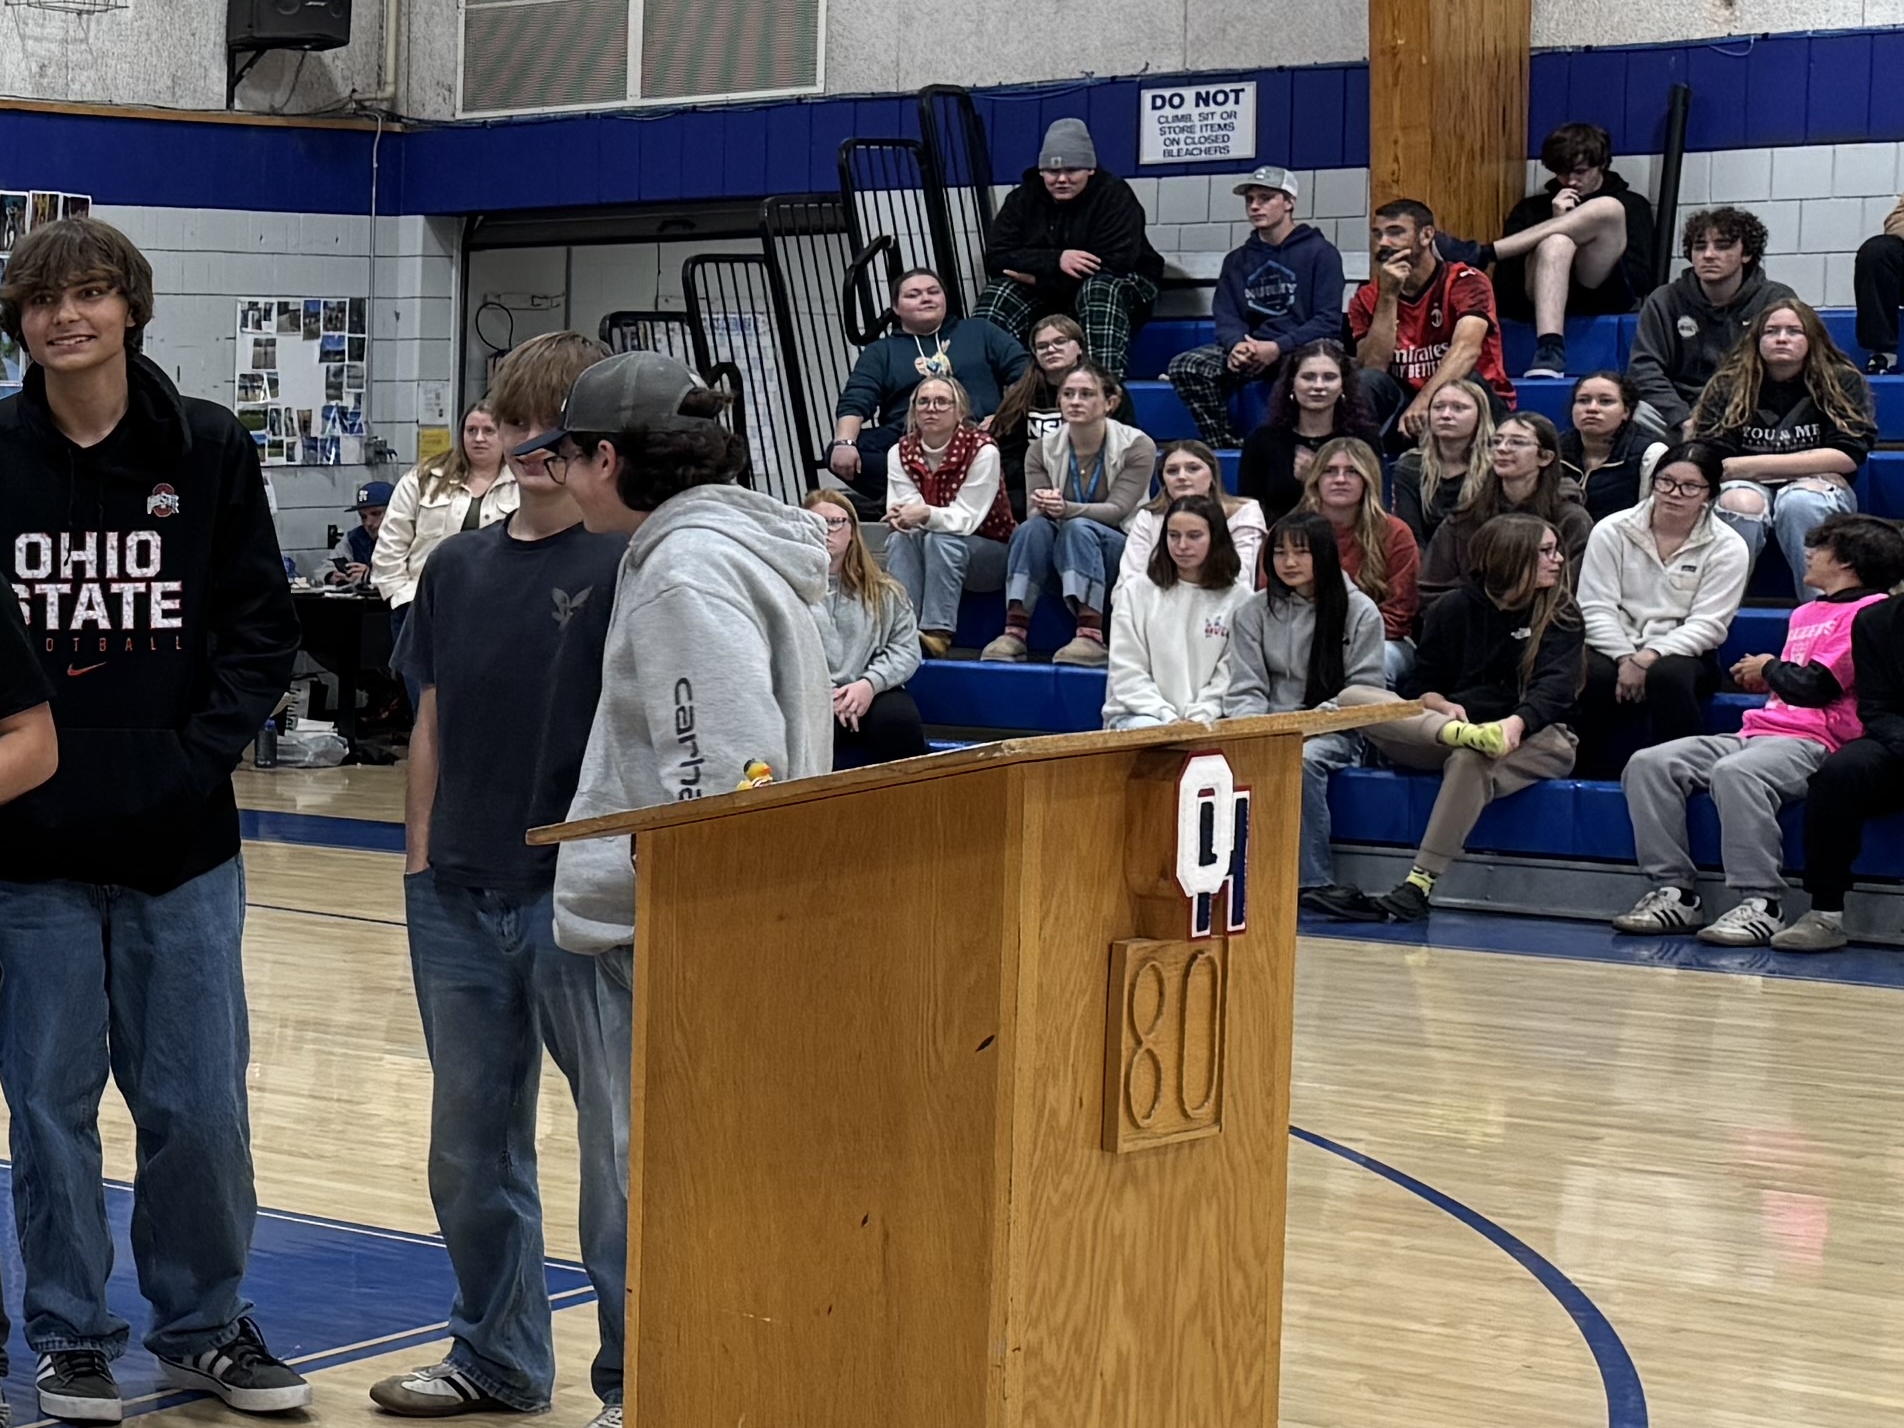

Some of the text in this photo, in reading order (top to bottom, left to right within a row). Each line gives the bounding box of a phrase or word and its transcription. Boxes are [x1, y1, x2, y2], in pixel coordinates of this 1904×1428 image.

[1151, 88, 1245, 110] DO NOT
[1198, 111, 1216, 122] SIT
[1220, 110, 1237, 120] OR
[1159, 122, 1235, 136] STORE ITEMS
[1163, 134, 1230, 147] ON CLOSED
[1163, 145, 1230, 158] BLEACHERS
[1394, 342, 1449, 363] mirates
[15, 530, 161, 579] OHIO
[46, 636, 182, 652] OTBALL
[1124, 949, 1222, 1130] 80
